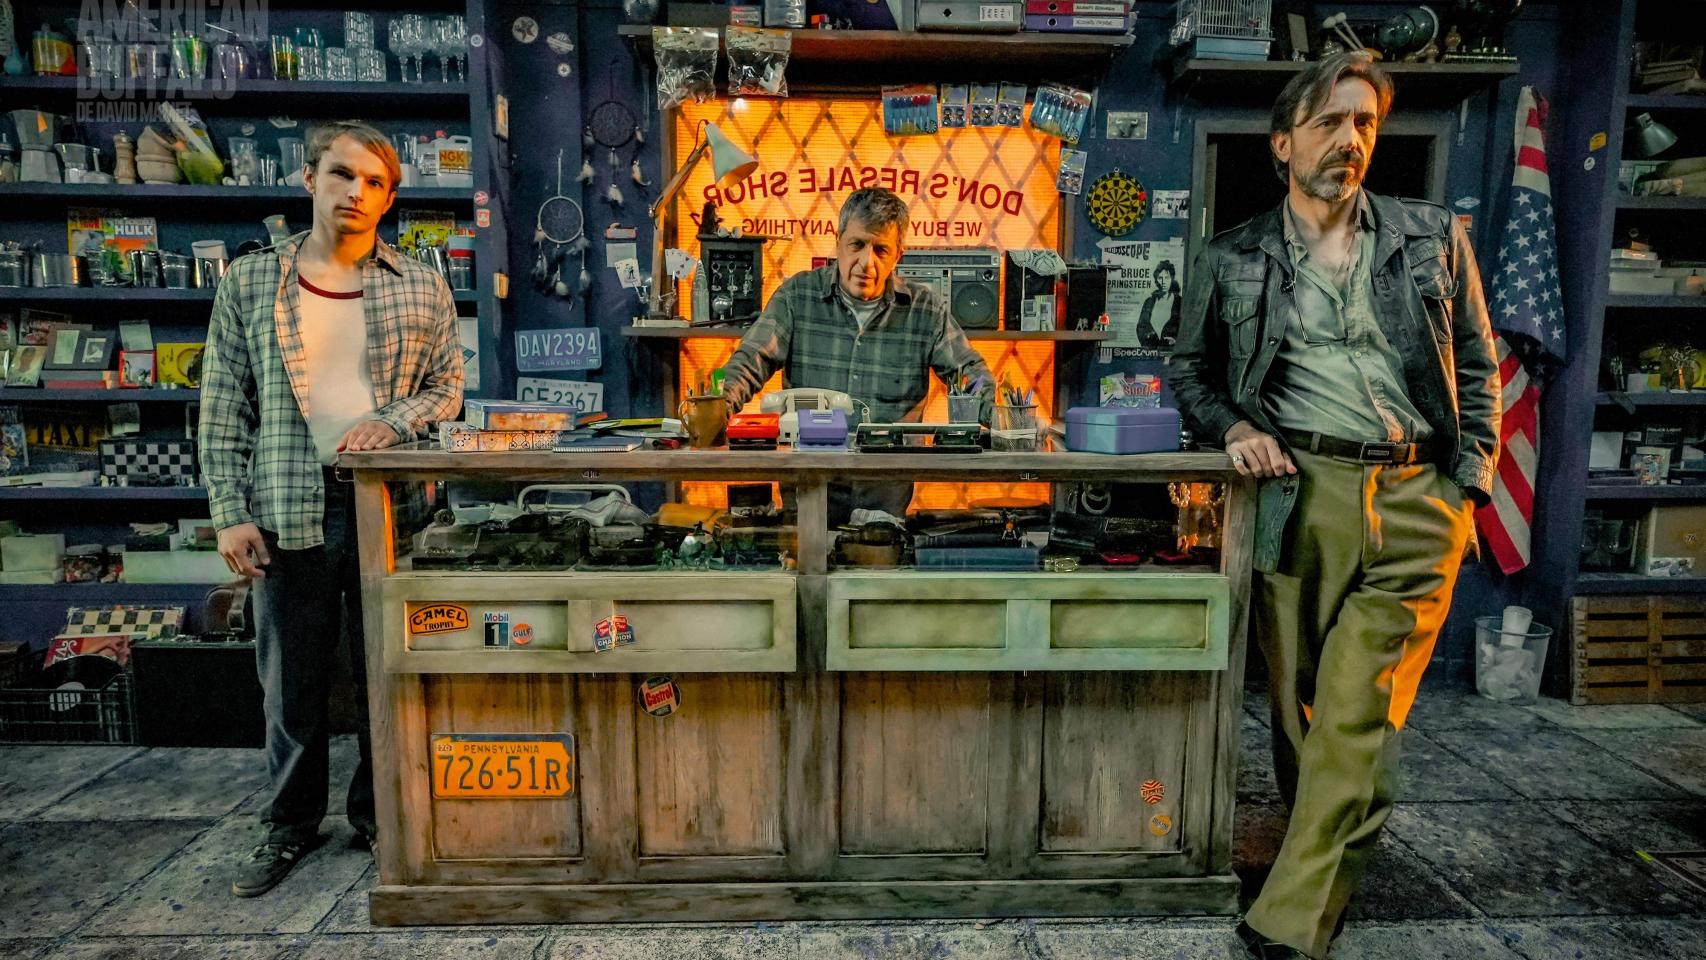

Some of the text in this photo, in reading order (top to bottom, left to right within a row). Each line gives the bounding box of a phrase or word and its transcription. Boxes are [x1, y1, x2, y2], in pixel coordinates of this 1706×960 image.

[440, 151, 465, 163] NGK
[115, 224, 154, 236] HULK
[1121, 268, 1150, 279] BRUCE
[1107, 280, 1151, 289] PRINGSTEEN
[519, 332, 597, 357] DAV2394
[1113, 347, 1158, 357] Spectrum
[37, 421, 93, 448] TAXI
[413, 608, 465, 626] CAMEL
[484, 613, 508, 622] Mobil
[423, 620, 454, 631] TROPHY
[491, 623, 500, 645] 1
[597, 632, 632, 647] CHAPION
[646, 683, 673, 706] Castrol
[463, 744, 540, 754] PENNSYLVANIA
